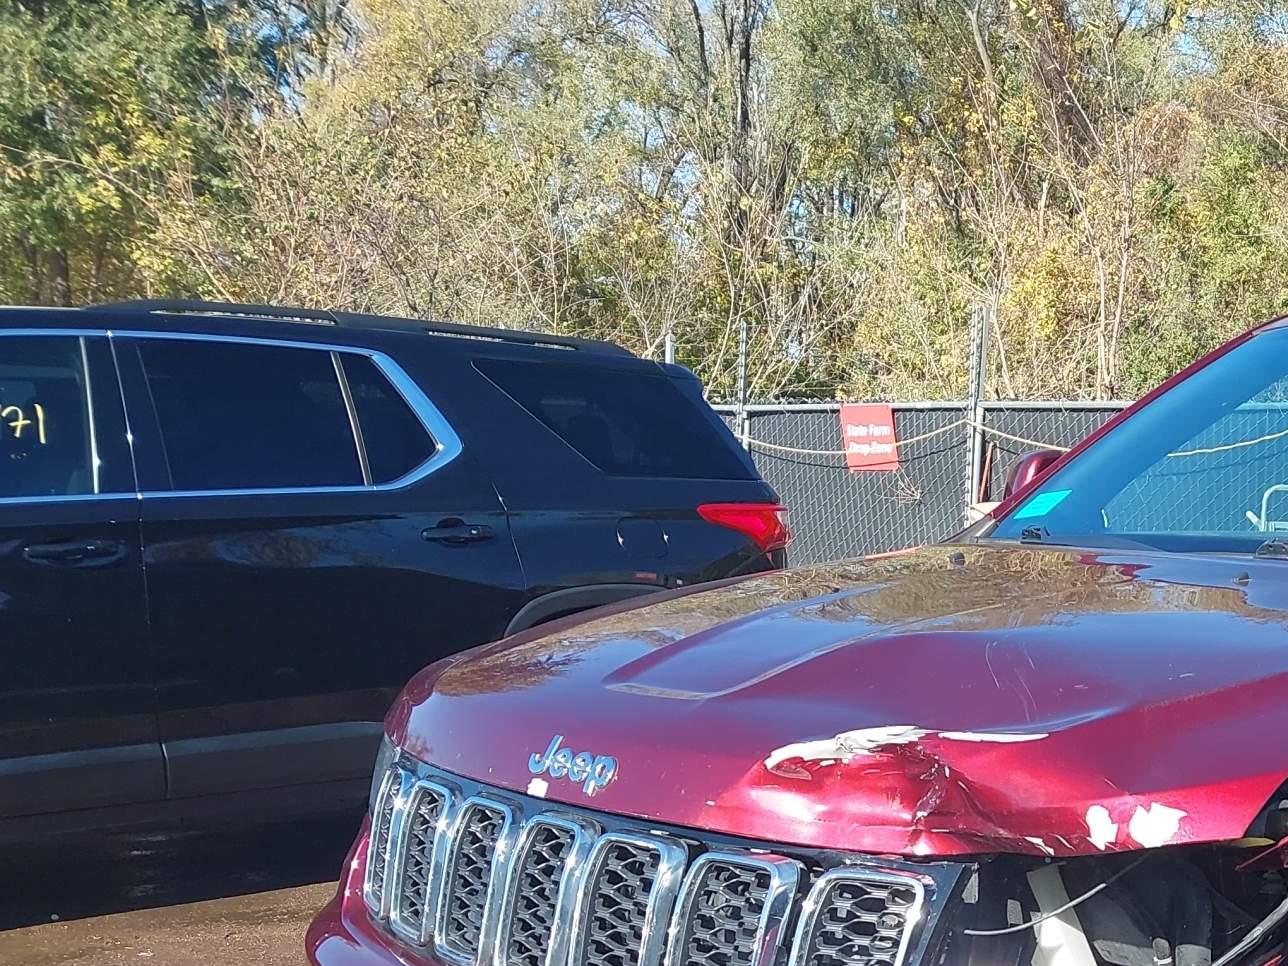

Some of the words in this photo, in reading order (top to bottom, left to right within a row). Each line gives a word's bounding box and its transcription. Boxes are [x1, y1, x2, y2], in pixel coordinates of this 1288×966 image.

[0, 403, 46, 444] 71
[847, 424, 868, 437] State
[869, 424, 890, 437] Farm
[528, 735, 618, 797] Jeep
